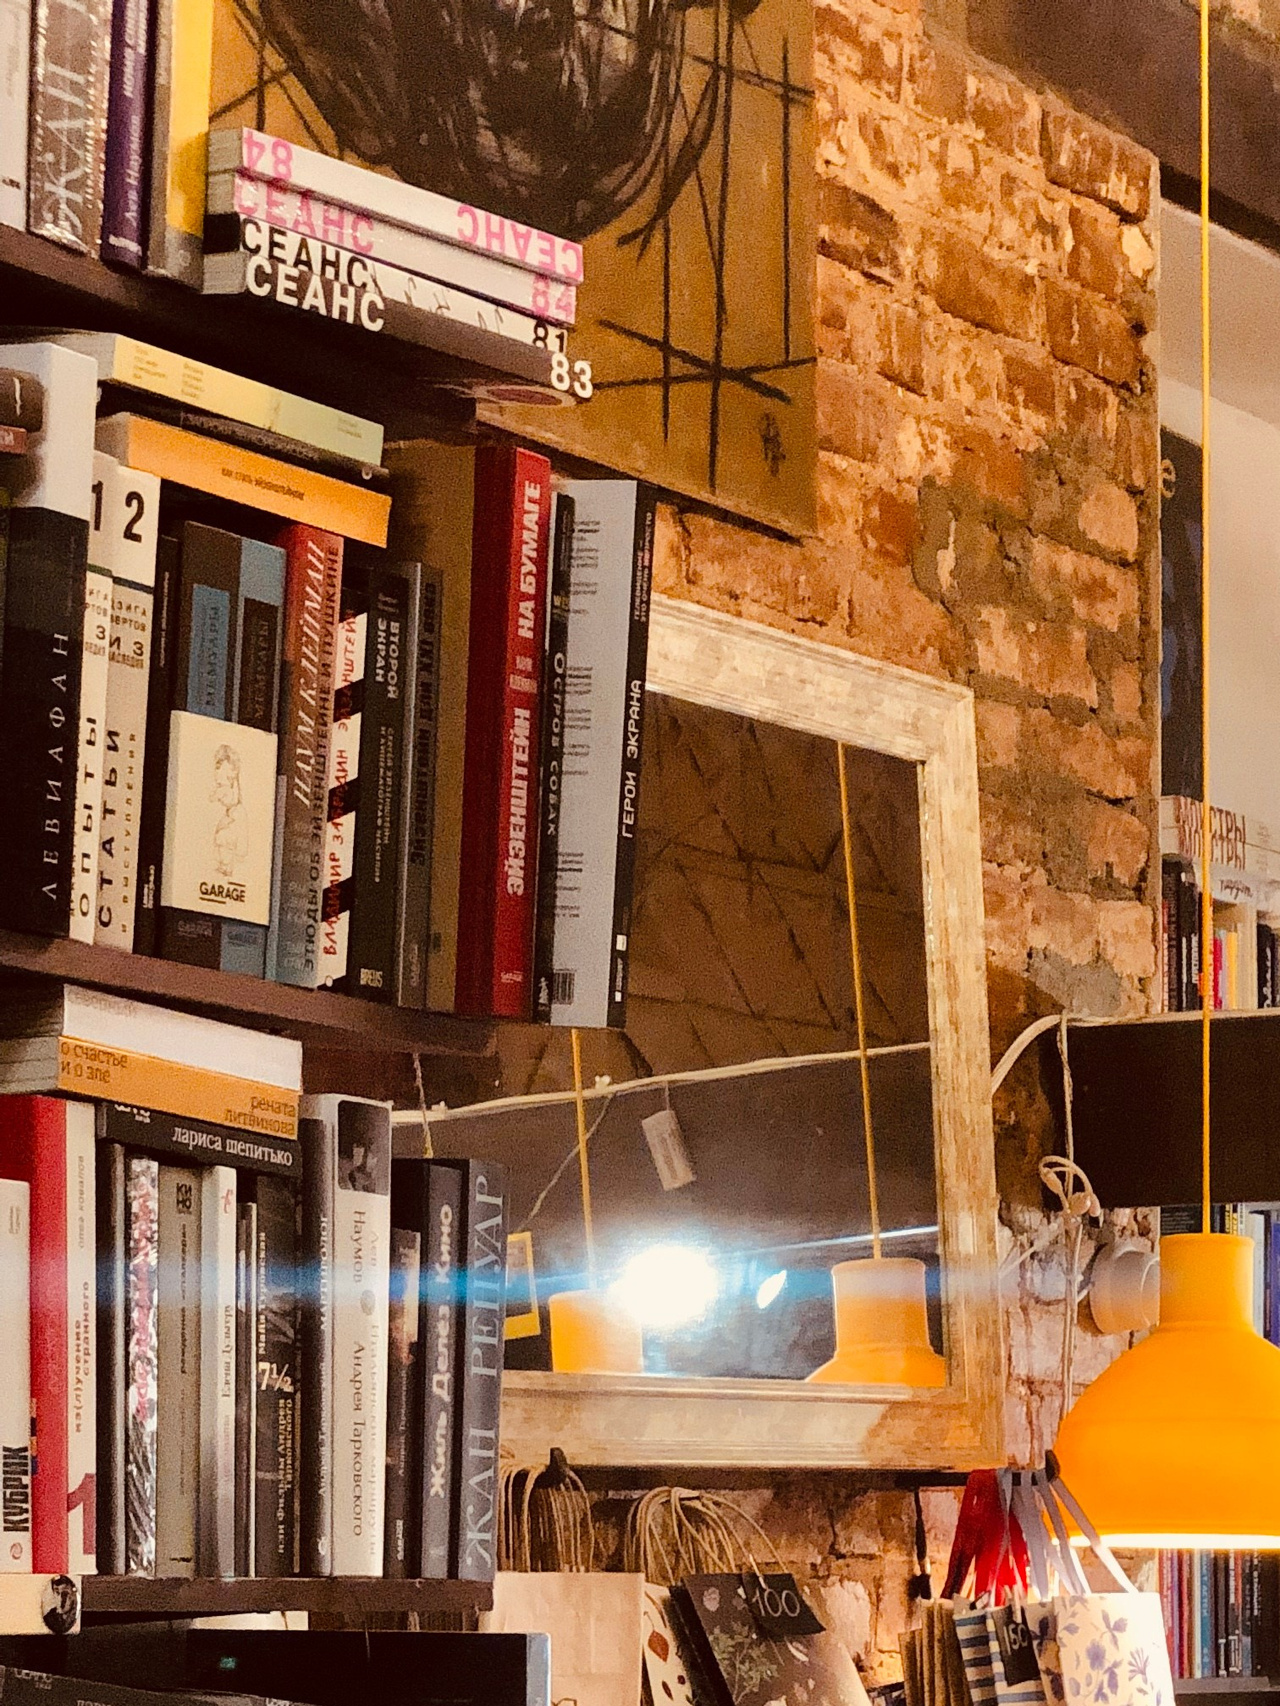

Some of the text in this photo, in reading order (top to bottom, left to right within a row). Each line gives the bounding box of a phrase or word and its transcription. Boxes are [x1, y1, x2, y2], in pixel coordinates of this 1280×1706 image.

[246, 130, 293, 180] 84
[234, 174, 375, 254] СЕАНС
[242, 217, 369, 290] СЕАНС
[457, 205, 583, 277] СЕАНС
[248, 255, 385, 332] СЕАНС
[531, 275, 575, 321] 84
[532, 320, 567, 354] 81
[550, 351, 594, 399] 83
[123, 490, 146, 543] 2
[517, 480, 542, 597] БУМАГЕ
[375, 617, 388, 683] ЭКРАН
[386, 620, 401, 699] ВТОРОЙ
[516, 600, 536, 641] НА
[293, 540, 326, 807] НАУМ КЛЕЙМАН
[42, 632, 70, 901] ЛЕВИАФАН
[304, 545, 341, 971] ЭТЮДЫ ОБ ЭЙЗЕНШТЕЙНЕ И ПУШКИНЕ
[547, 652, 567, 837] ОСТРОВ СОБАК
[622, 679, 642, 839] ГЕРОИ ЭКРАНА
[77, 716, 98, 918] ОПЫТЫ
[98, 729, 121, 929] СТАТЬИ
[122, 731, 137, 905] ВЫСТУПЛЕНИЯ
[506, 707, 533, 897] ЭЙЗЕНШТЕЙН
[199, 881, 247, 903] GARAGE
[322, 851, 343, 956] ВЛАДИМИР
[60, 1041, 128, 1068] о счастье
[60, 1060, 111, 1084] и о зле
[172, 1126, 294, 1167] лариса шепитько
[250, 1096, 296, 1118] рената
[350, 1210, 367, 1284] Наумов
[81, 1281, 91, 1377] странного
[430, 1203, 453, 1499] Жиль Кино
[466, 1174, 503, 1568] ЖАН РЕНУАР
[349, 1341, 367, 1537] Андрея Тарковского
[2, 1445, 30, 1533] КУБРИК
[752, 1585, 801, 1615] 100
